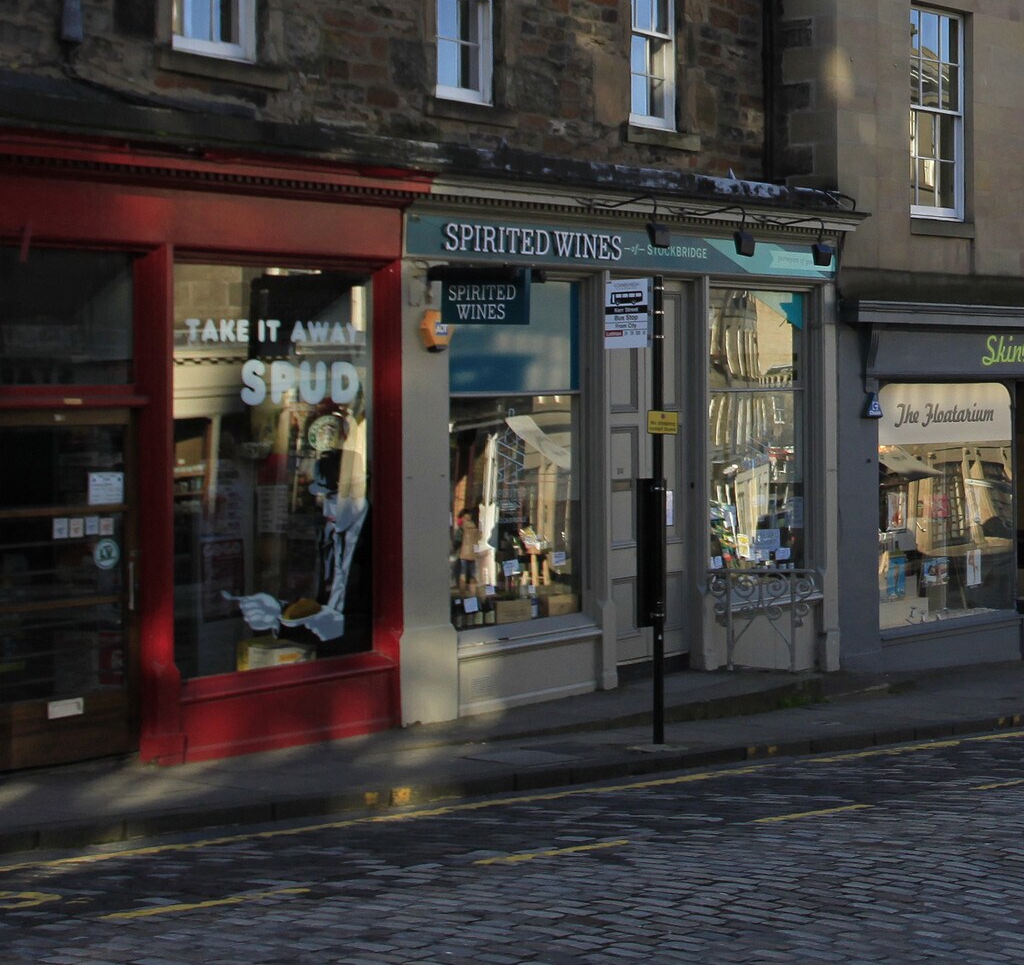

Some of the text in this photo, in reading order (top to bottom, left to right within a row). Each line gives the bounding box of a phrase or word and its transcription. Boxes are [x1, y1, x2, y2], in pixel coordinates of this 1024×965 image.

[443, 222, 550, 256] SPIRITED
[554, 229, 623, 261] WINES
[448, 283, 517, 302] SPIRITED
[455, 303, 506, 321] WINES
[626, 314, 639, 322] Stop
[184, 318, 358, 344] TAKE IT AWAY
[239, 359, 360, 406] SPUD
[894, 402, 994, 428] The Floatarium
